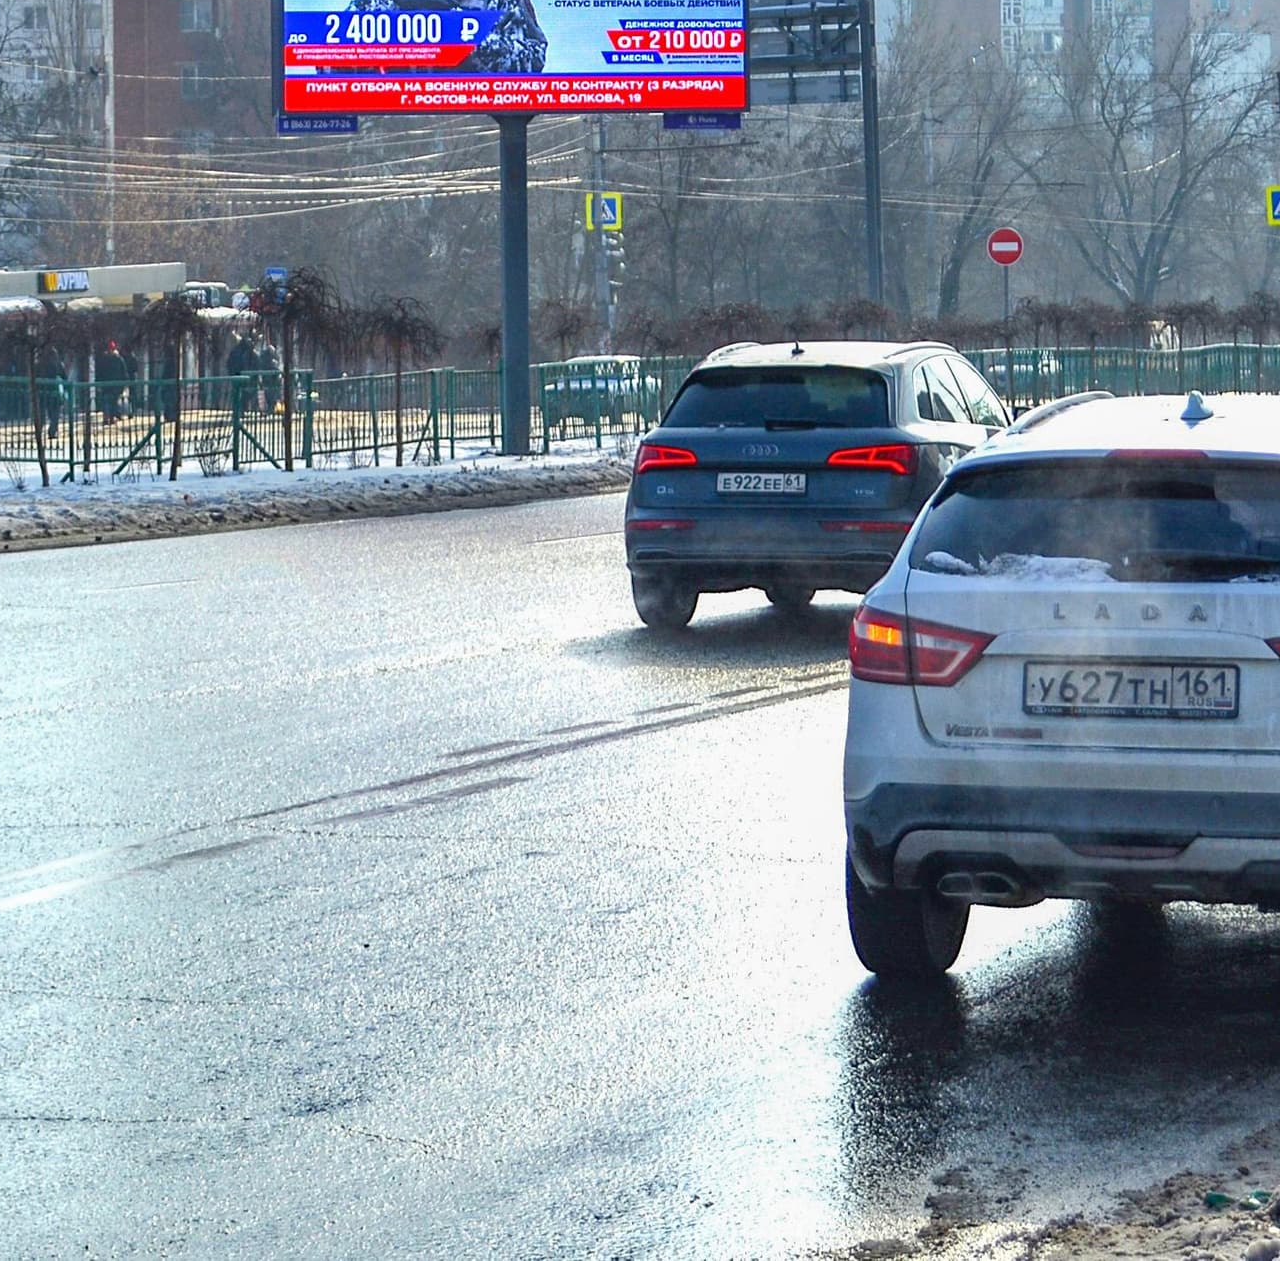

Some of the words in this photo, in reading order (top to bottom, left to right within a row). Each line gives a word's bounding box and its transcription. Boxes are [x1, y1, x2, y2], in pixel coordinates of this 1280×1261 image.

[554, 0, 590, 8] СТАТУС
[593, 0, 641, 8] ВЕТЕРАНА
[644, 0, 685, 8] БОЕВЫХ
[687, 0, 741, 8] ДЕЙСТВИЙ
[625, 21, 675, 29] ДЕНЕЖНОЕ
[677, 20, 743, 29] ДОВОЛЬСТВИЕ
[621, 54, 655, 62] МЕСЯЦ
[306, 83, 347, 92] ПУНКТ
[350, 82, 401, 92] ОТБОРА
[405, 82, 421, 92] НА
[425, 82, 489, 92] ВОЕННУЮ
[493, 81, 547, 91] СЛУЖБУ
[550, 81, 569, 90] ПО
[572, 80, 644, 91] КОНТРАКТУ
[647, 80, 660, 91] (3
[663, 80, 724, 91] РАЗРЯДА)
[400, 95, 411, 105] Г.
[415, 94, 533, 105] РОСТОВ-НА-ДОНУ,
[536, 94, 556, 104] УЛ.
[560, 94, 624, 104] ВОЛКОВА,
[628, 94, 642, 104] 19
[1052, 603, 1208, 622] LADA
[1038, 670, 1168, 706] У627ТН
[1177, 670, 1227, 697] 161
[1187, 697, 1214, 708] RUS
